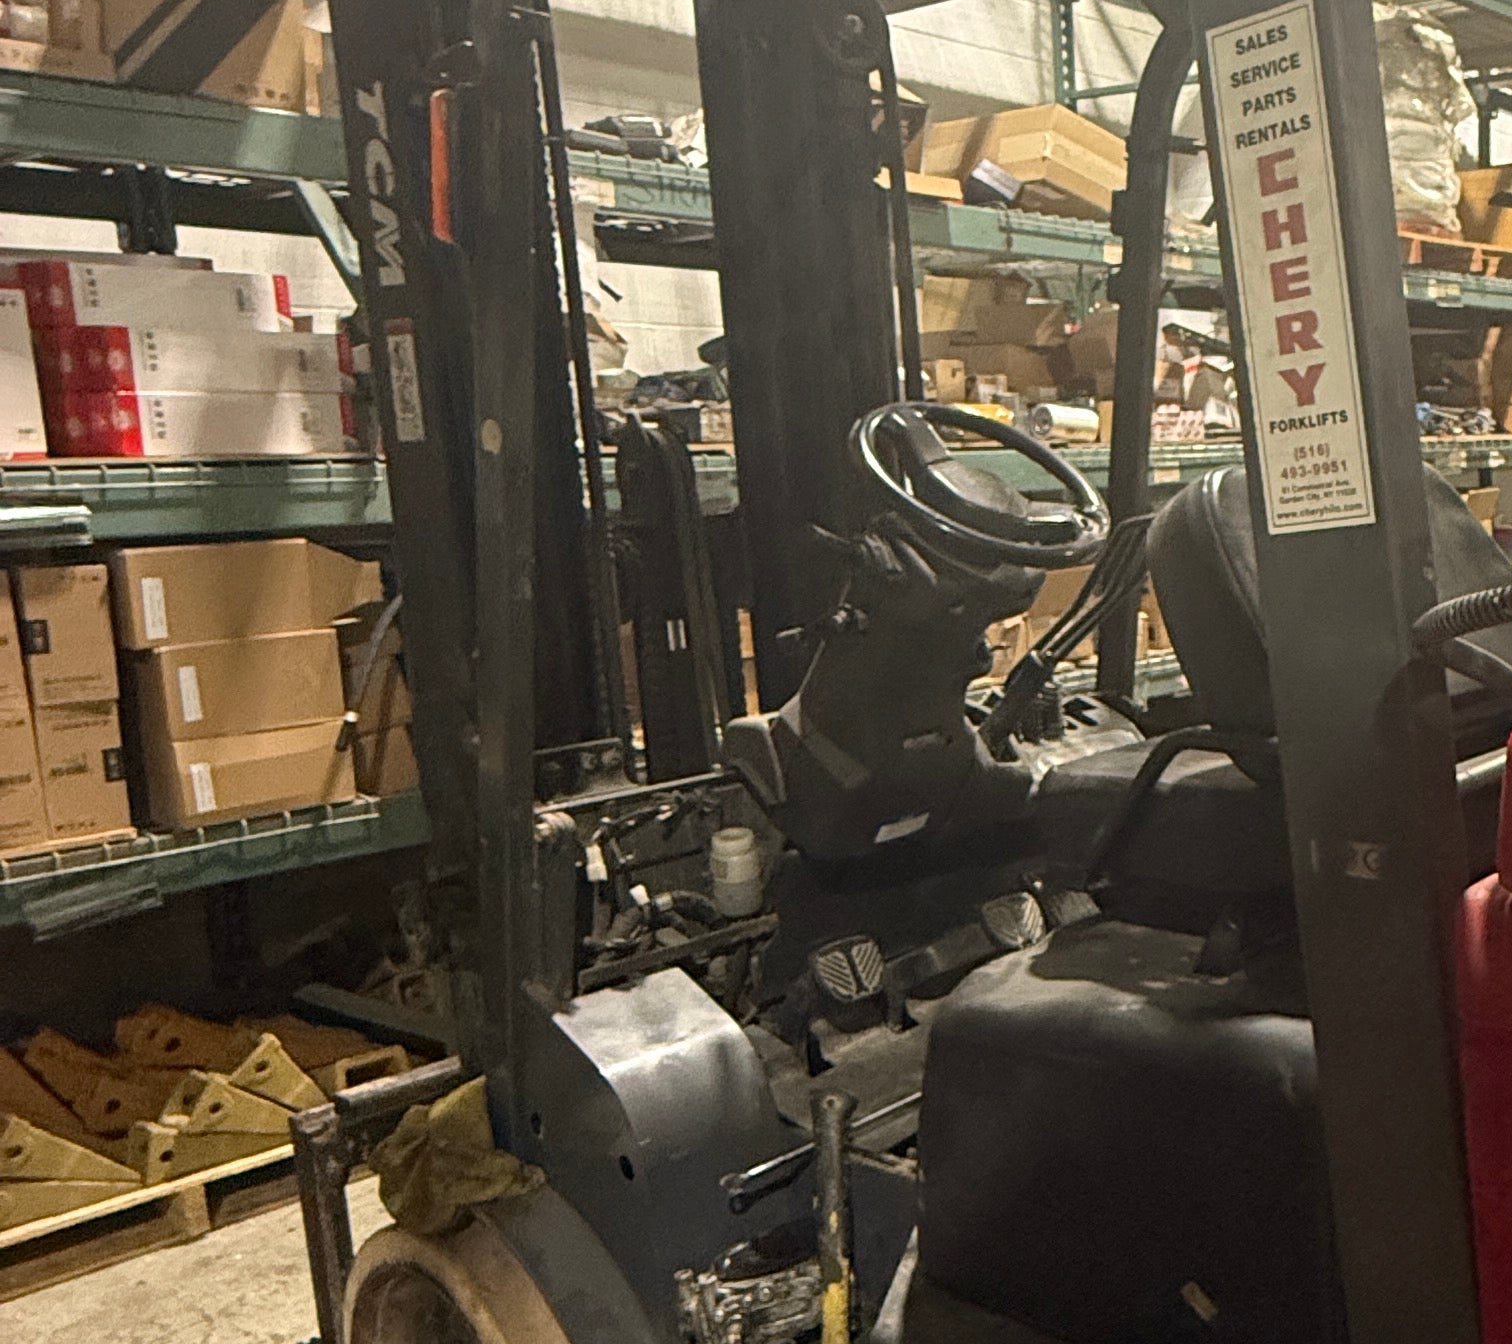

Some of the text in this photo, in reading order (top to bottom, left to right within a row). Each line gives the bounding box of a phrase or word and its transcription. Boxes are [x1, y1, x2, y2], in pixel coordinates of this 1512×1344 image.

[1235, 24, 1288, 55] SALES
[1230, 52, 1301, 88] SERVICE
[1241, 86, 1297, 117] PARTS
[1235, 114, 1311, 149] RENTALS
[356, 79, 406, 286] TCM
[1256, 147, 1327, 407] CHERY
[1269, 409, 1348, 435] FORKLIFTS
[1293, 442, 1330, 462] (516)
[1281, 459, 1347, 480] 493-9951
